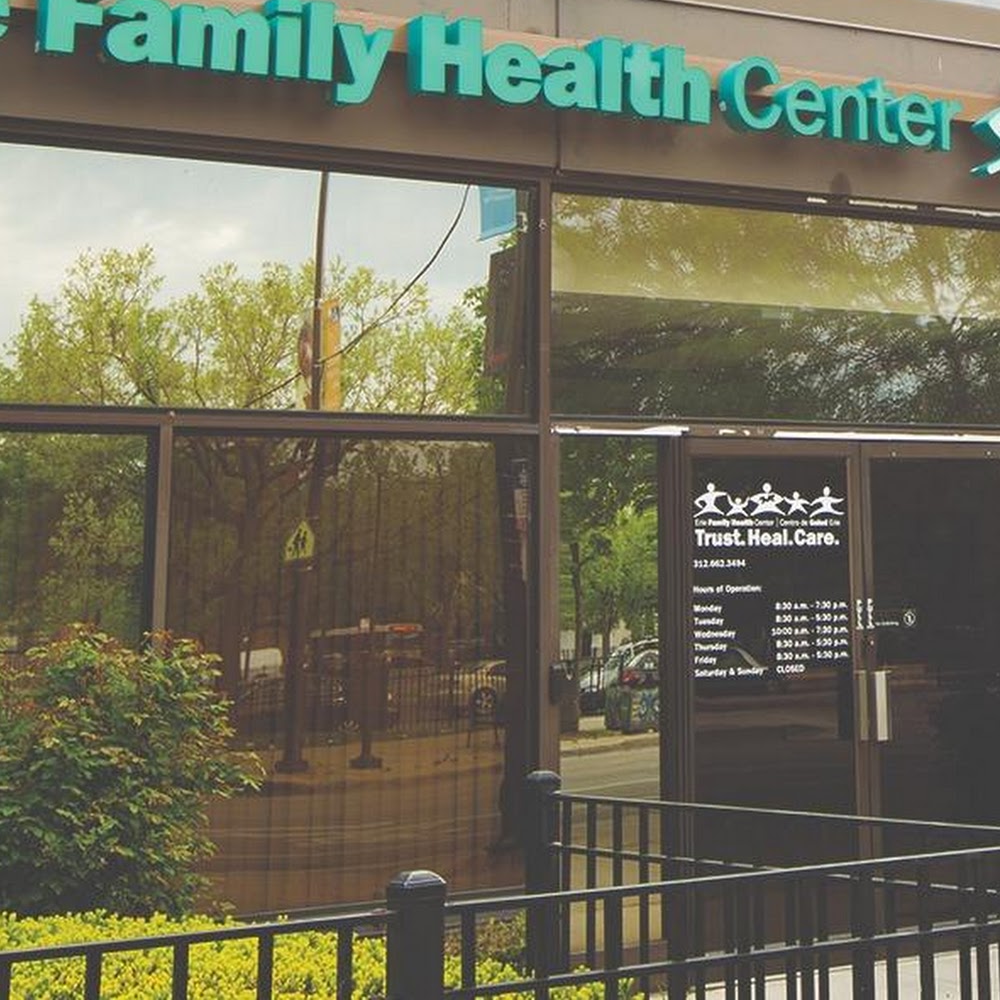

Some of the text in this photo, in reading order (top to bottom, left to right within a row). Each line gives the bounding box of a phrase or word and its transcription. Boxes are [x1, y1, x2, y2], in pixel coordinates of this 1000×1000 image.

[408, 12, 712, 125] Health
[718, 55, 963, 152] Center
[694, 528, 840, 547] Trust. Heal. Care.
[692, 585, 715, 594] Hours
[716, 585, 724, 594] of
[693, 604, 722, 614] Monday
[694, 617, 724, 626] Tuesday
[693, 629, 736, 639] Wednesday
[694, 642, 727, 652] Thursday
[694, 655, 717, 665] Friday
[776, 664, 805, 674] CLOSED
